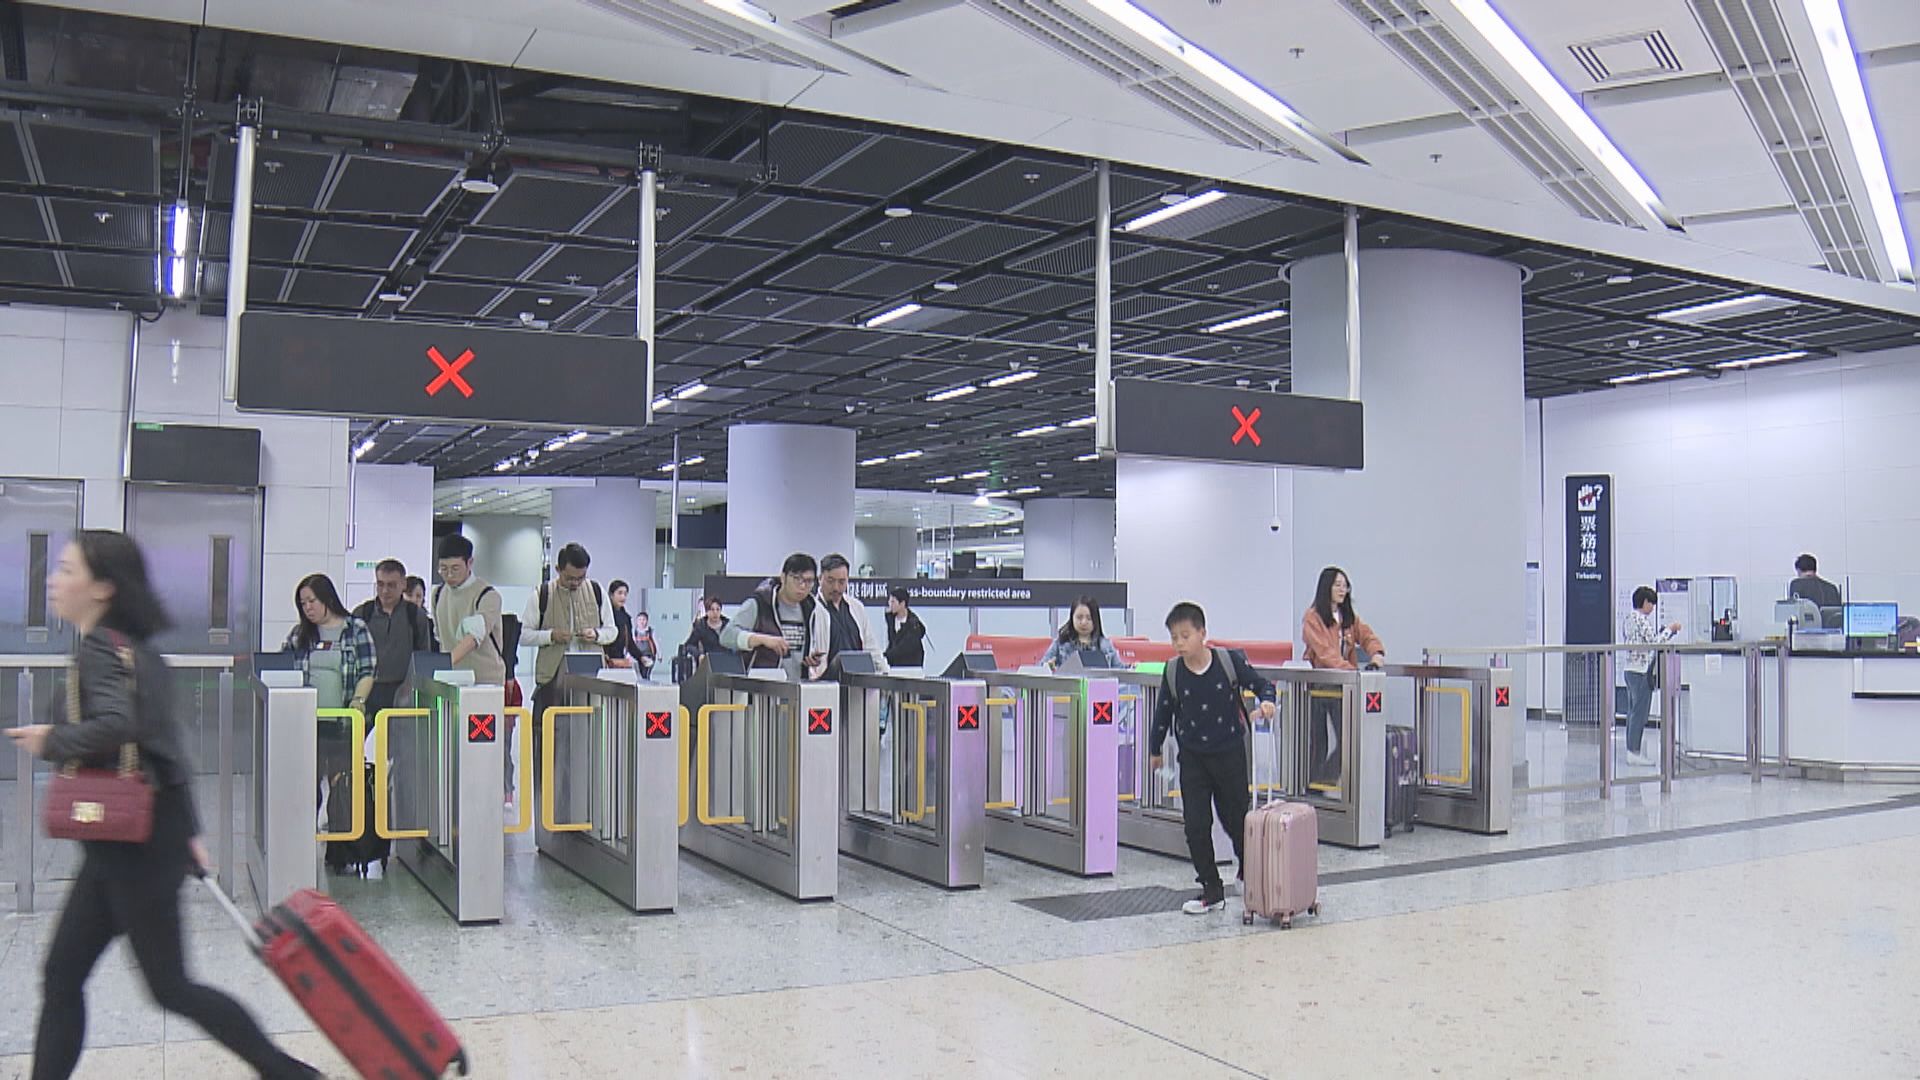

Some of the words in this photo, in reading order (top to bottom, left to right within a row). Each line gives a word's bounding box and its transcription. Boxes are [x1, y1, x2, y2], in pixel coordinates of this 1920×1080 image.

[1580, 514, 1597, 568] 票務處
[906, 586, 966, 601] ss-boundary
[967, 587, 1010, 599] restricted
[1011, 589, 1031, 600] area
